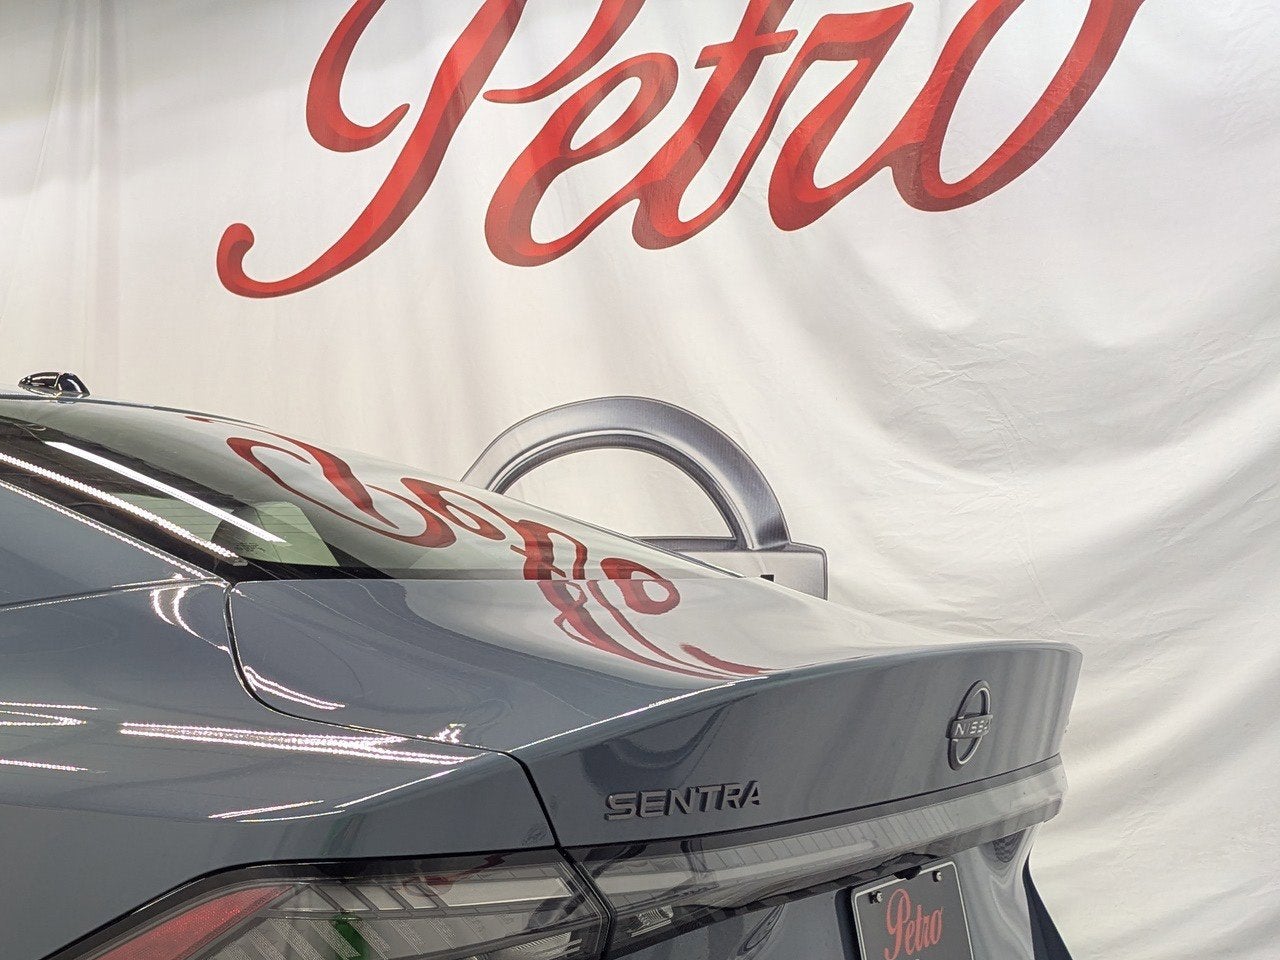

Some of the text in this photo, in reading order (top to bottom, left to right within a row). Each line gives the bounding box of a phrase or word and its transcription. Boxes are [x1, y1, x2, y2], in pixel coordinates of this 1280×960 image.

[217, 0, 1145, 298] Petro
[954, 719, 990, 736] NISS
[604, 780, 761, 821] SENTRA
